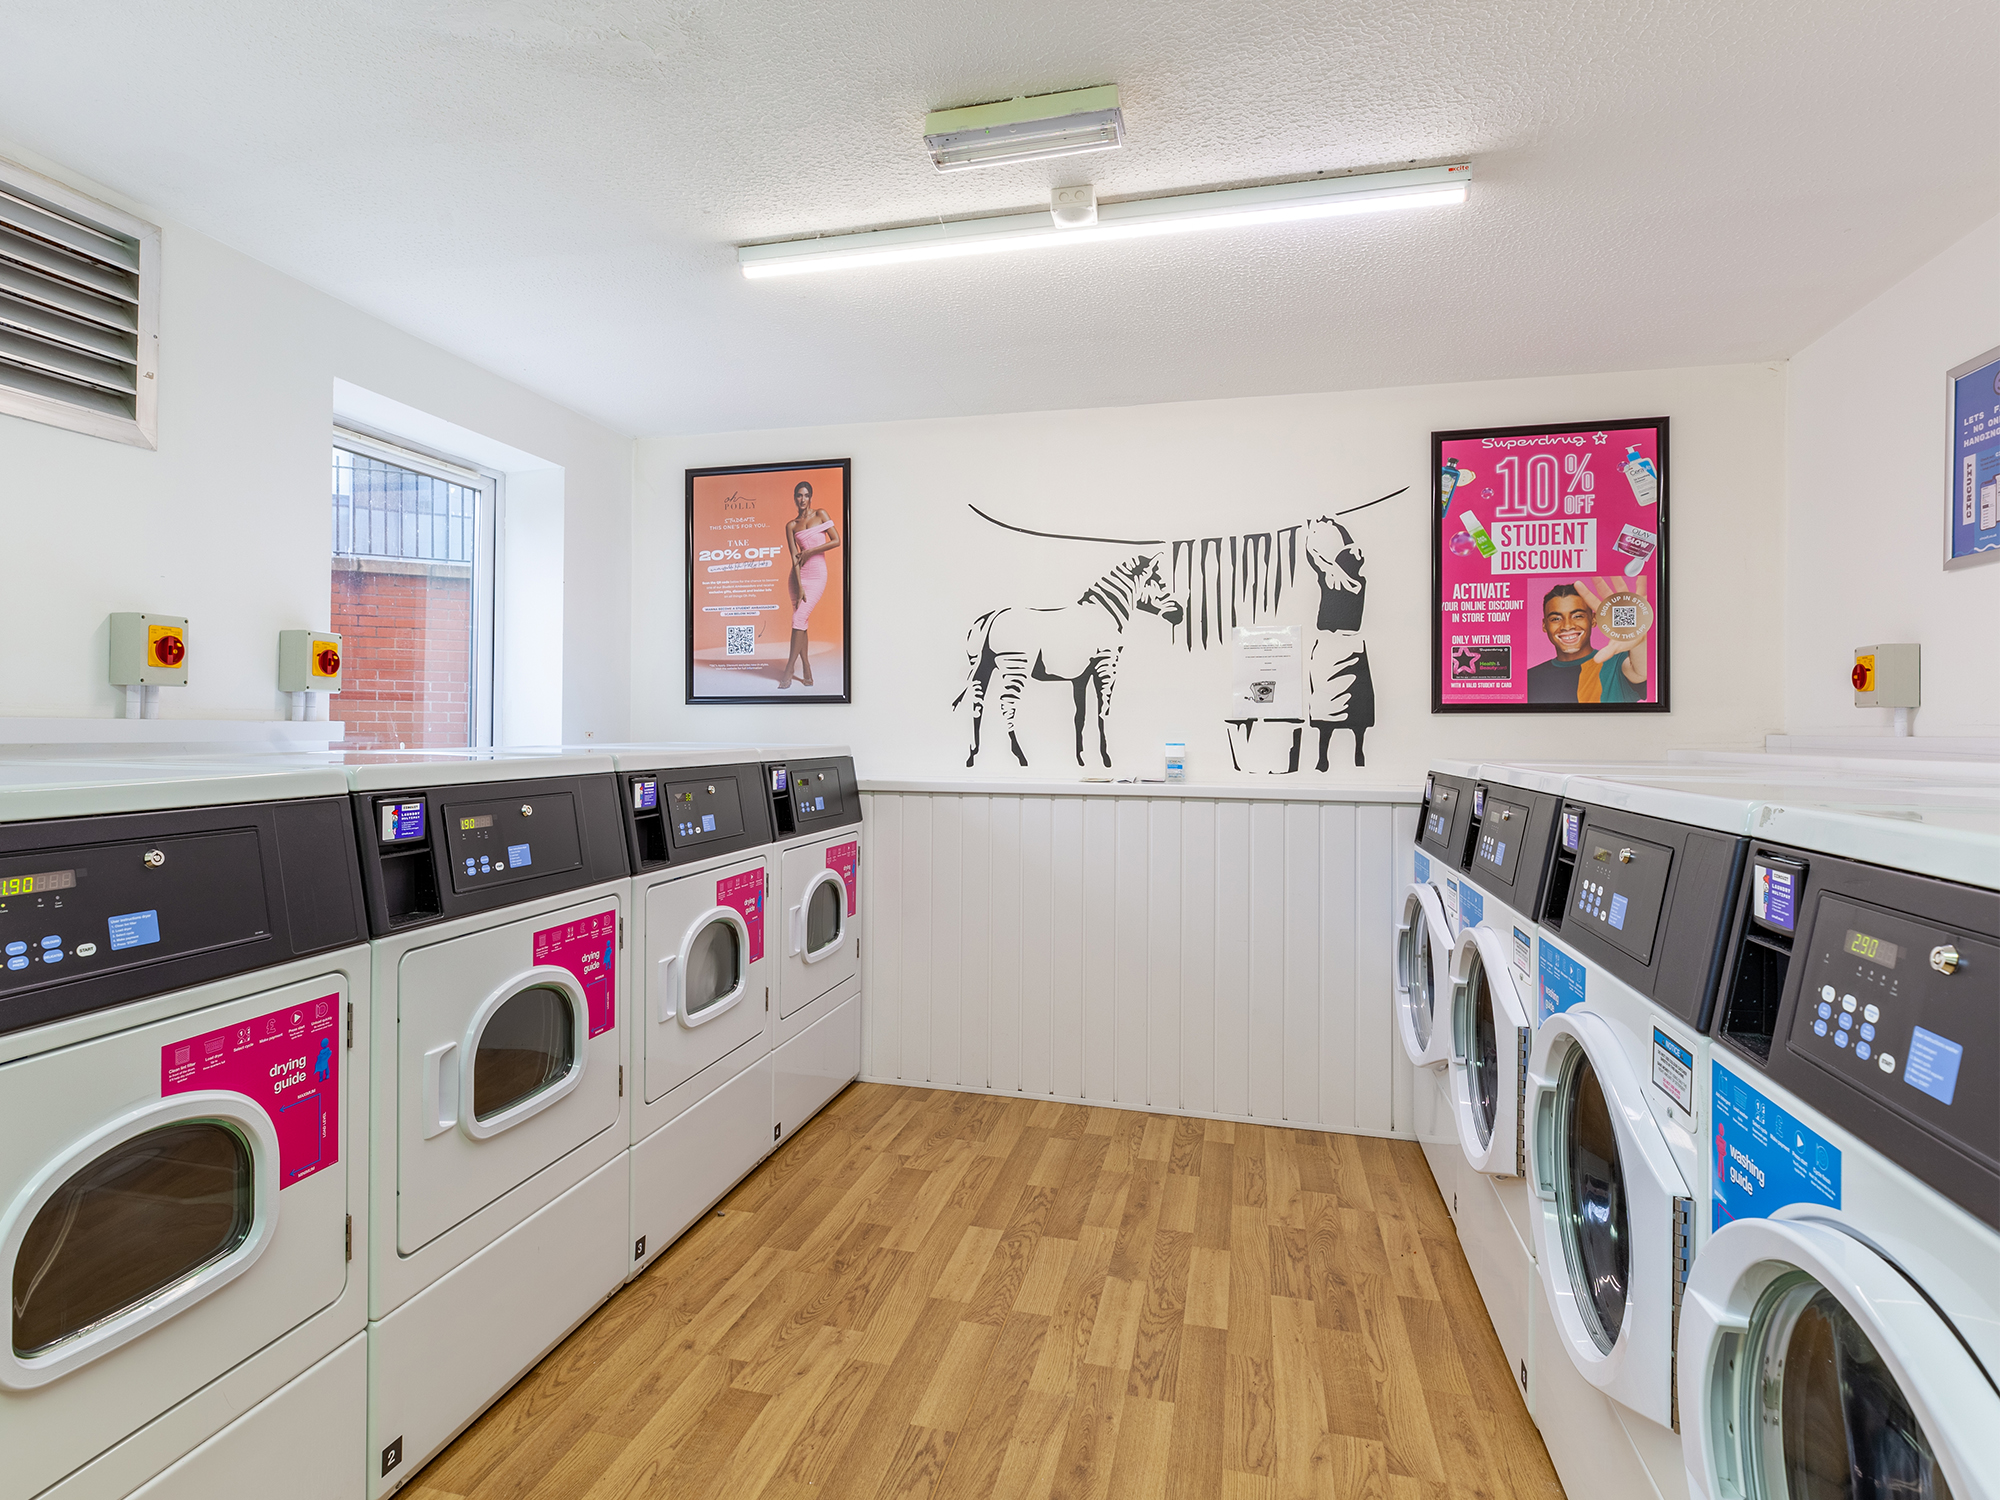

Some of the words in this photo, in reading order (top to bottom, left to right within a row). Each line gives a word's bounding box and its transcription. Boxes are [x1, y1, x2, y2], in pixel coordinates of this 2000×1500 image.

[1964, 411, 1985, 426] LETS
[1973, 423, 1984, 433] NO
[1481, 434, 1587, 450] Superdrug
[724, 502, 756, 510] POLLY
[1564, 494, 1596, 515] OFF
[724, 516, 755, 524] STUDENTS
[1501, 521, 1589, 547] STUDENT
[1632, 528, 1651, 538] OLAY
[727, 539, 750, 547] TAKE
[1625, 536, 1649, 549] GLOW
[699, 549, 742, 561] 20%
[1453, 582, 1511, 599] ACTIVATE
[1461, 601, 1486, 611] ONLINE
[1488, 600, 1524, 610] DISCOUNT
[1600, 601, 1612, 616] SIGN
[1632, 598, 1649, 616] STORE
[1452, 613, 1459, 623] IN
[1462, 613, 1485, 623] STORE
[1487, 612, 1511, 622] TODAY
[1602, 624, 1611, 633] OR
[1636, 624, 1646, 635] APP
[1452, 635, 1469, 644] ONLY
[1472, 635, 1490, 644] WITH
[1492, 634, 1511, 644] YOUR
[581, 950, 600, 963] drying
[583, 961, 600, 975] guide
[1665, 1040, 1681, 1057] NOTICE
[269, 1056, 307, 1078] drying
[274, 1071, 306, 1094] guide
[297, 1088, 316, 1099] MAXIMUM
[1729, 1144, 1765, 1189] washing
[1730, 1166, 1753, 1196] guide
[637, 1242, 642, 1254] 3
[387, 1449, 396, 1467] 2
